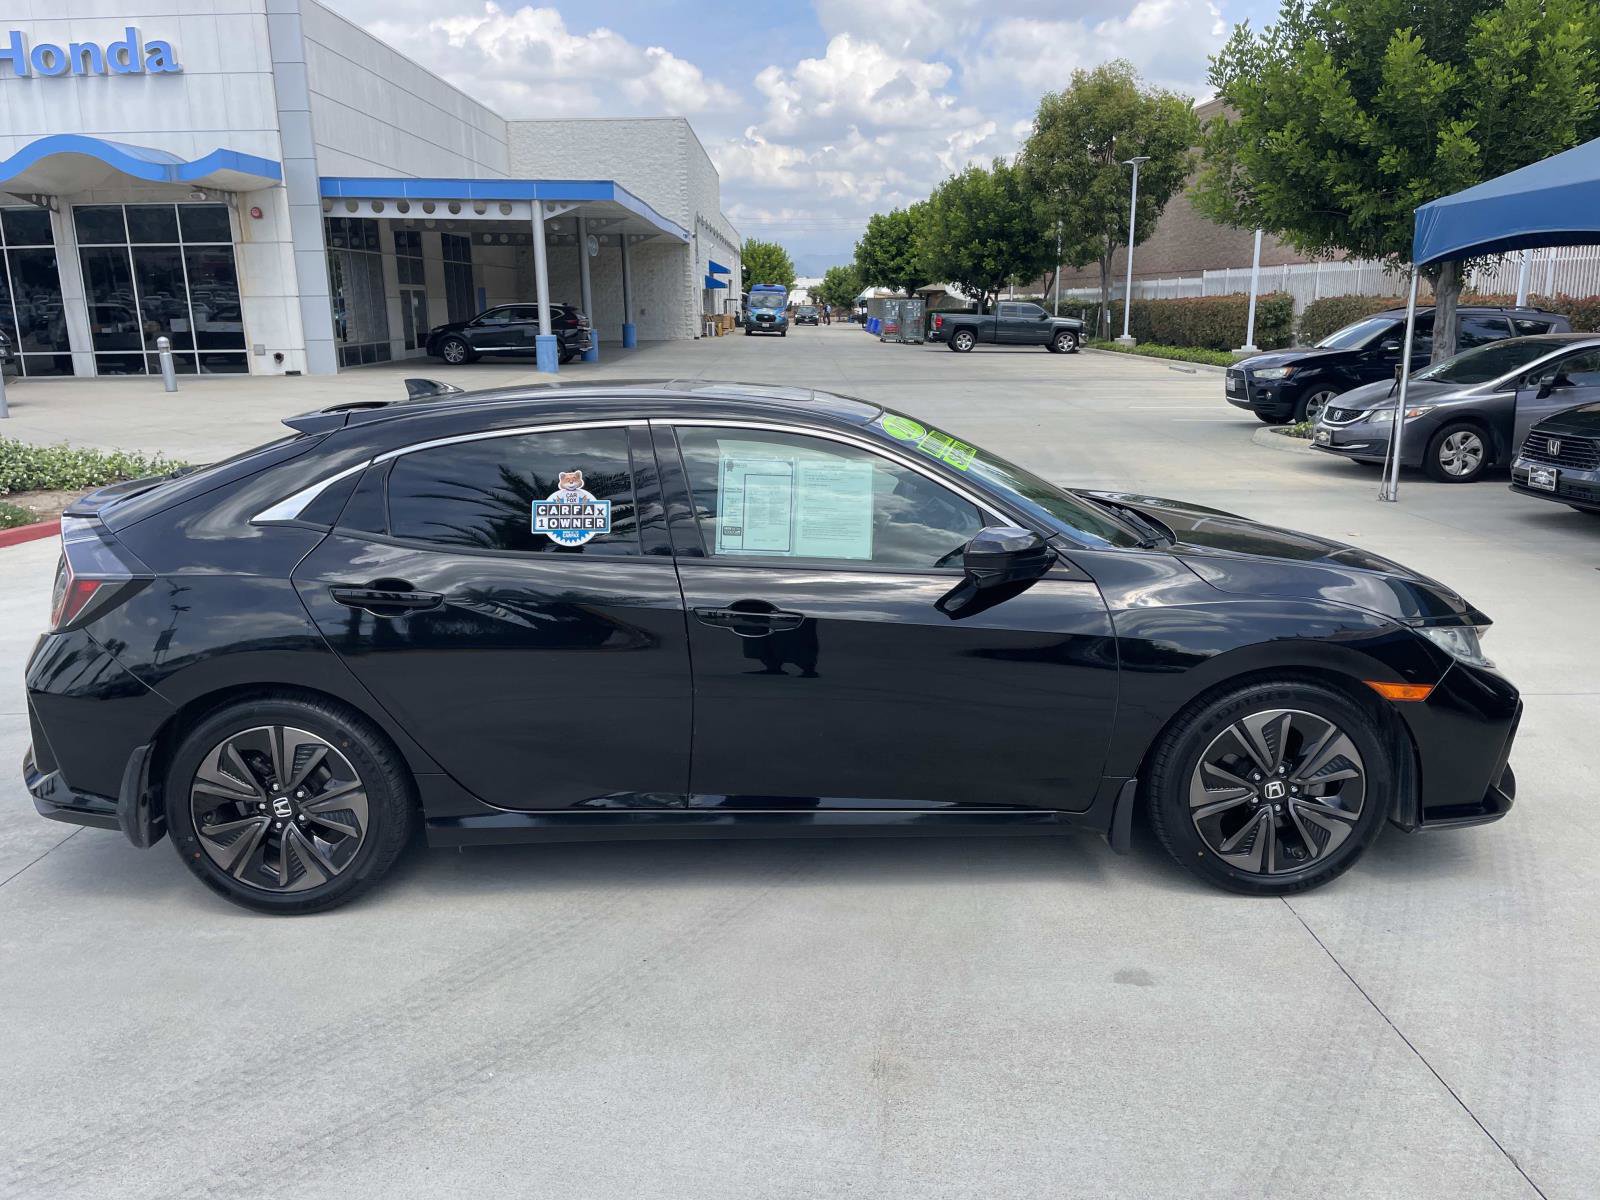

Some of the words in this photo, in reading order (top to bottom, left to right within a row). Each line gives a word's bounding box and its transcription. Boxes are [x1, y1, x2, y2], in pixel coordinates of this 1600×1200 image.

[538, 505, 605, 516] CARFAX
[538, 518, 546, 528] 1
[549, 518, 605, 528] OWNER
